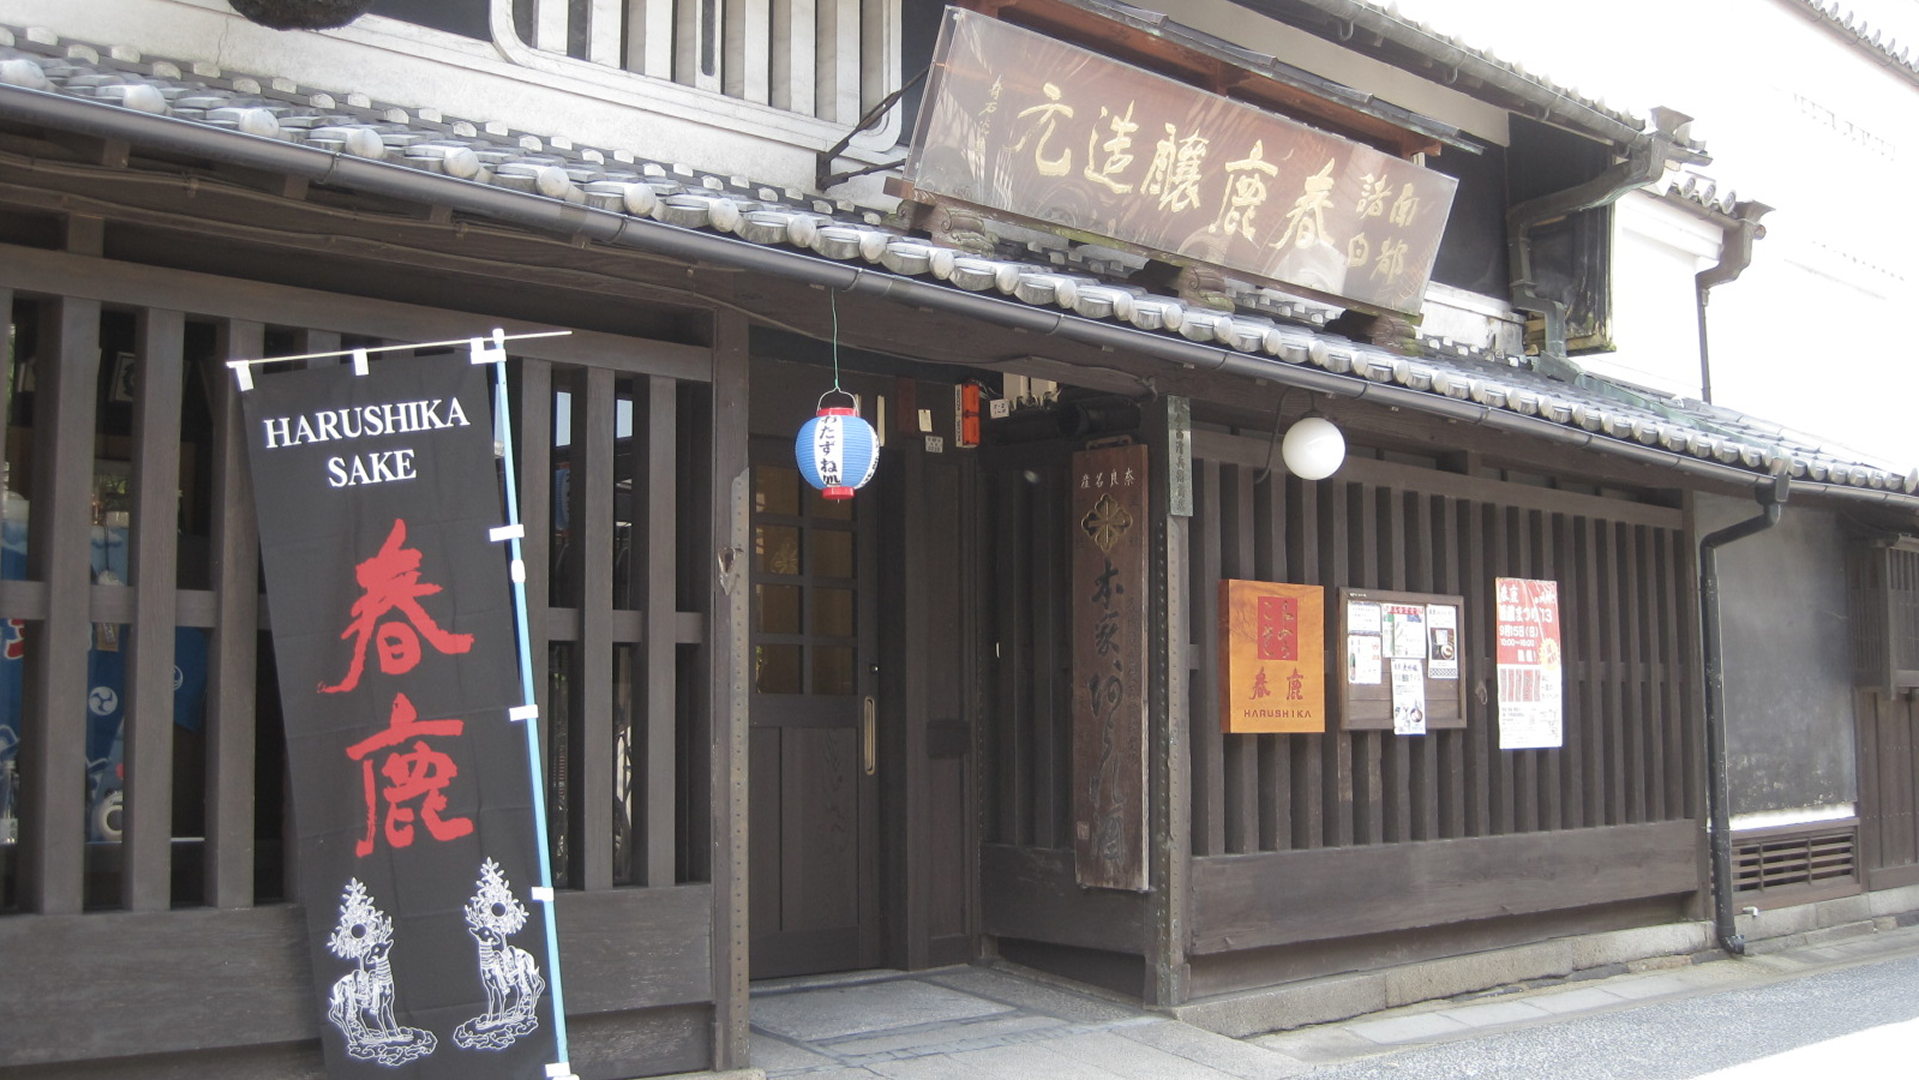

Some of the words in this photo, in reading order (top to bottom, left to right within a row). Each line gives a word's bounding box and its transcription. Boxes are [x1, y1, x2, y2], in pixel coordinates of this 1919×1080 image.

[262, 396, 471, 449] HARUSHIKA
[328, 448, 417, 488] SAKE
[316, 517, 475, 858] 春鹿
[1249, 667, 1304, 701] 春鹿
[1243, 708, 1312, 719] HARUSHIKA
